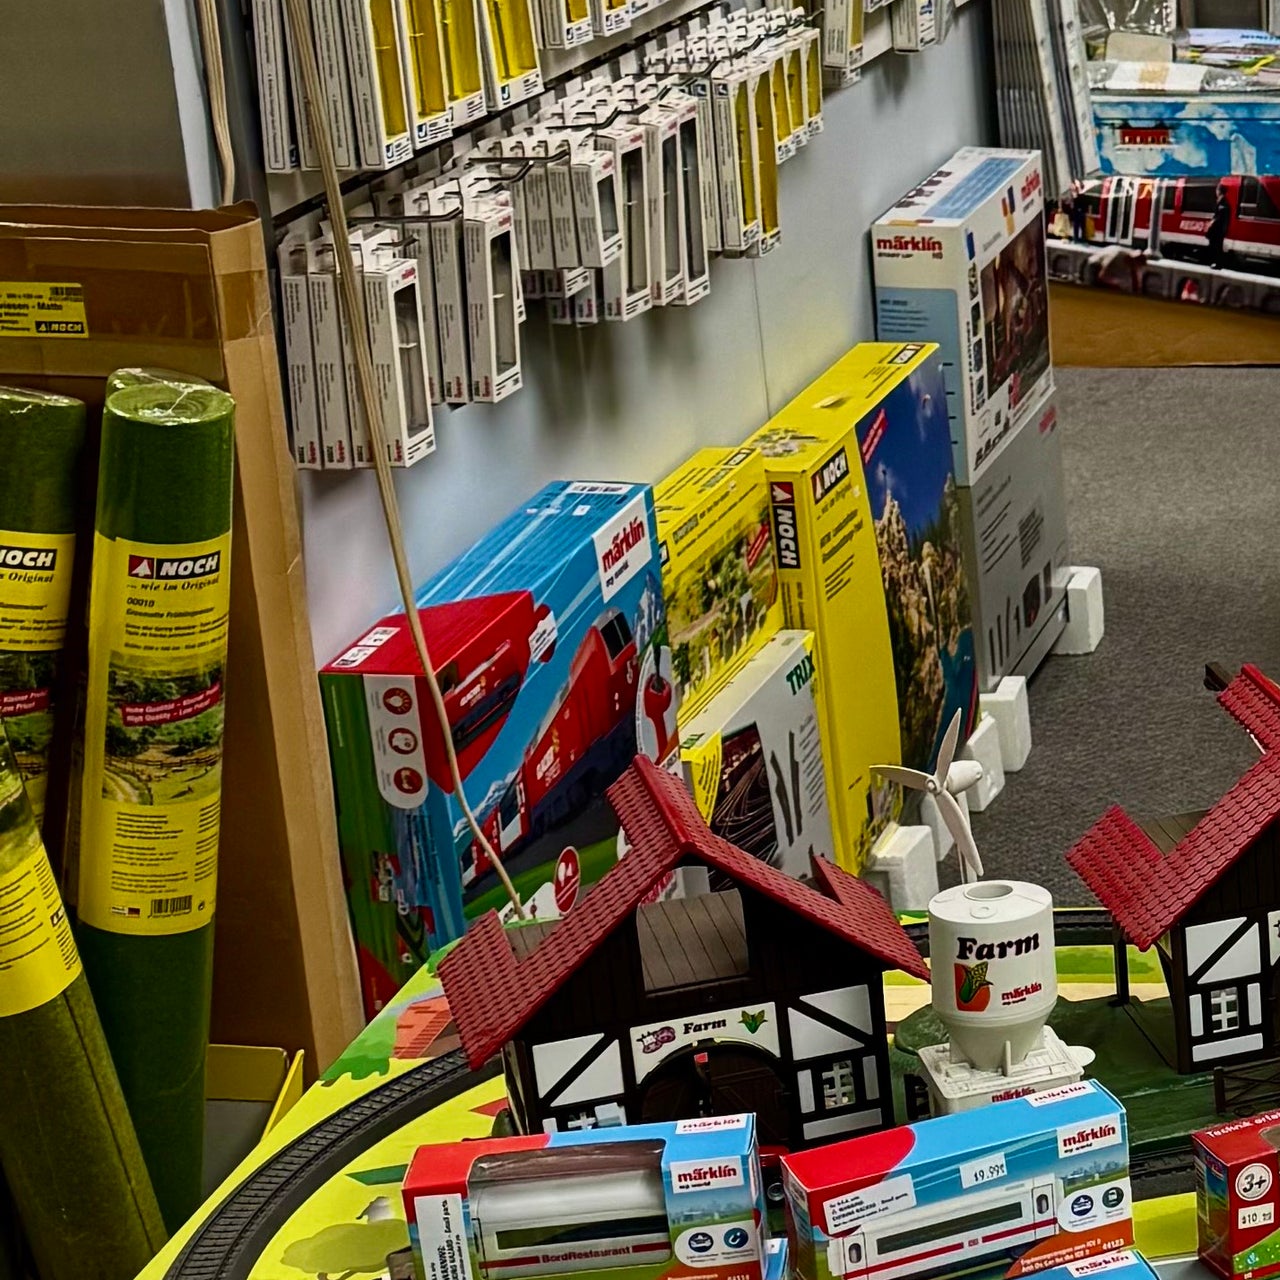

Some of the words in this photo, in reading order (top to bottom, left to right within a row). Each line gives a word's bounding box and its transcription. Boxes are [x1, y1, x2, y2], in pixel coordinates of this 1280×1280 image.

[823, 452, 849, 489] NOCH
[778, 508, 797, 567] NOCH
[160, 554, 218, 577] NOCH
[181, 575, 219, 591] Original
[785, 656, 816, 696] TRIX
[956, 931, 1040, 961] Farm
[682, 1017, 727, 1035] Farm
[1206, 1121, 1246, 1138] Technik
[1241, 1172, 1267, 1193] 3+
[541, 1245, 631, 1264] BordRestaurant
